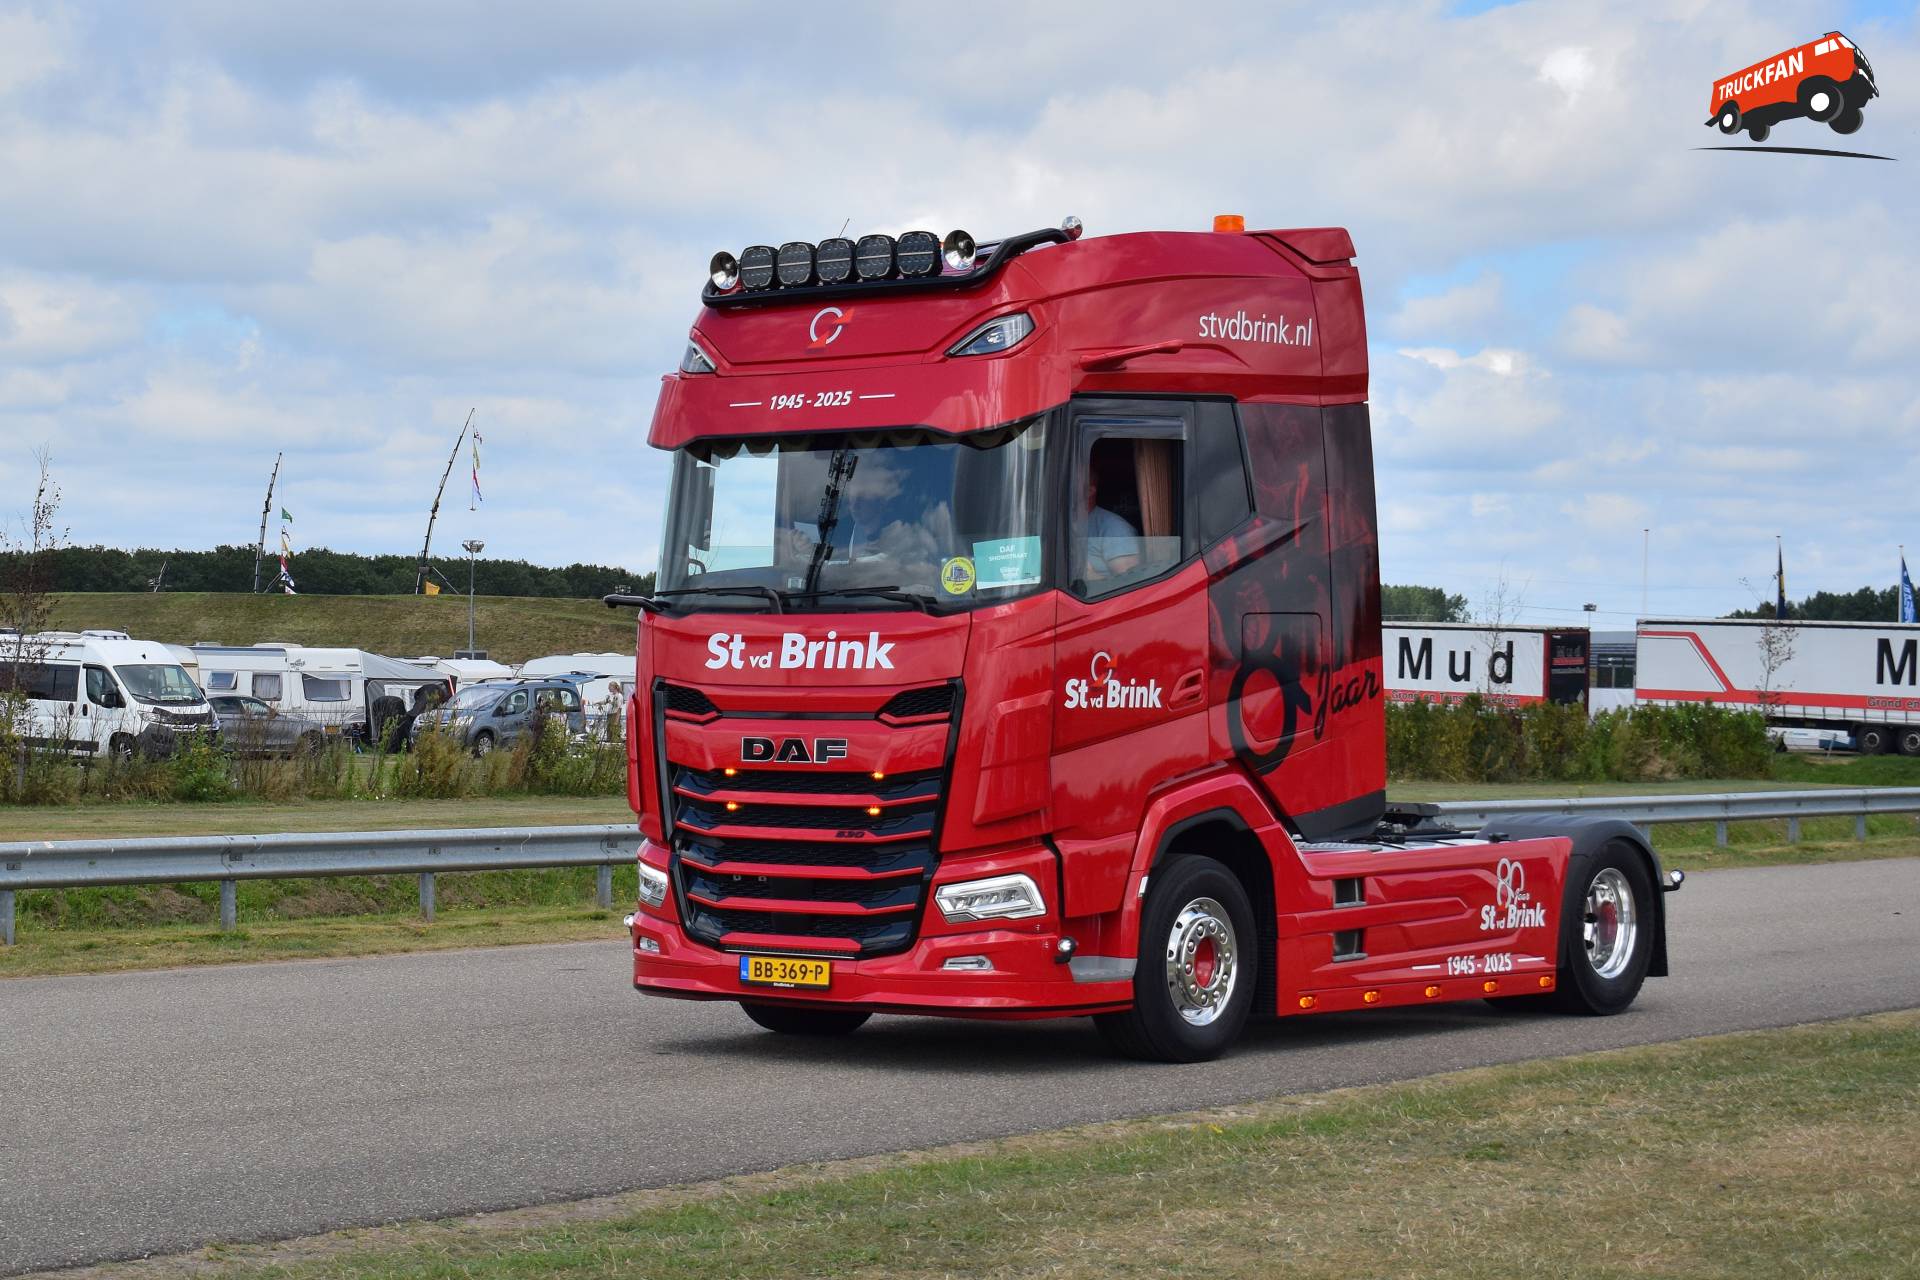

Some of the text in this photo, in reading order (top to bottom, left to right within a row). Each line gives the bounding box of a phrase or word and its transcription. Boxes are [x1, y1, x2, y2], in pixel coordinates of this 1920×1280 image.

[1198, 310, 1313, 347] stvdbrink.nl
[770, 394, 805, 410] 1945
[814, 391, 852, 407] 2025
[704, 630, 896, 670] St vd Brink
[1398, 637, 1514, 684] Mud
[1063, 678, 1162, 709] St vd Brink
[1313, 663, 1380, 741] Jaar
[741, 736, 848, 763] DAF
[1480, 904, 1496, 930] St
[1506, 902, 1547, 929] Brink
[754, 961, 824, 981] BB-369-P
[1447, 955, 1475, 976] 1945
[1483, 952, 1512, 973] 2025
